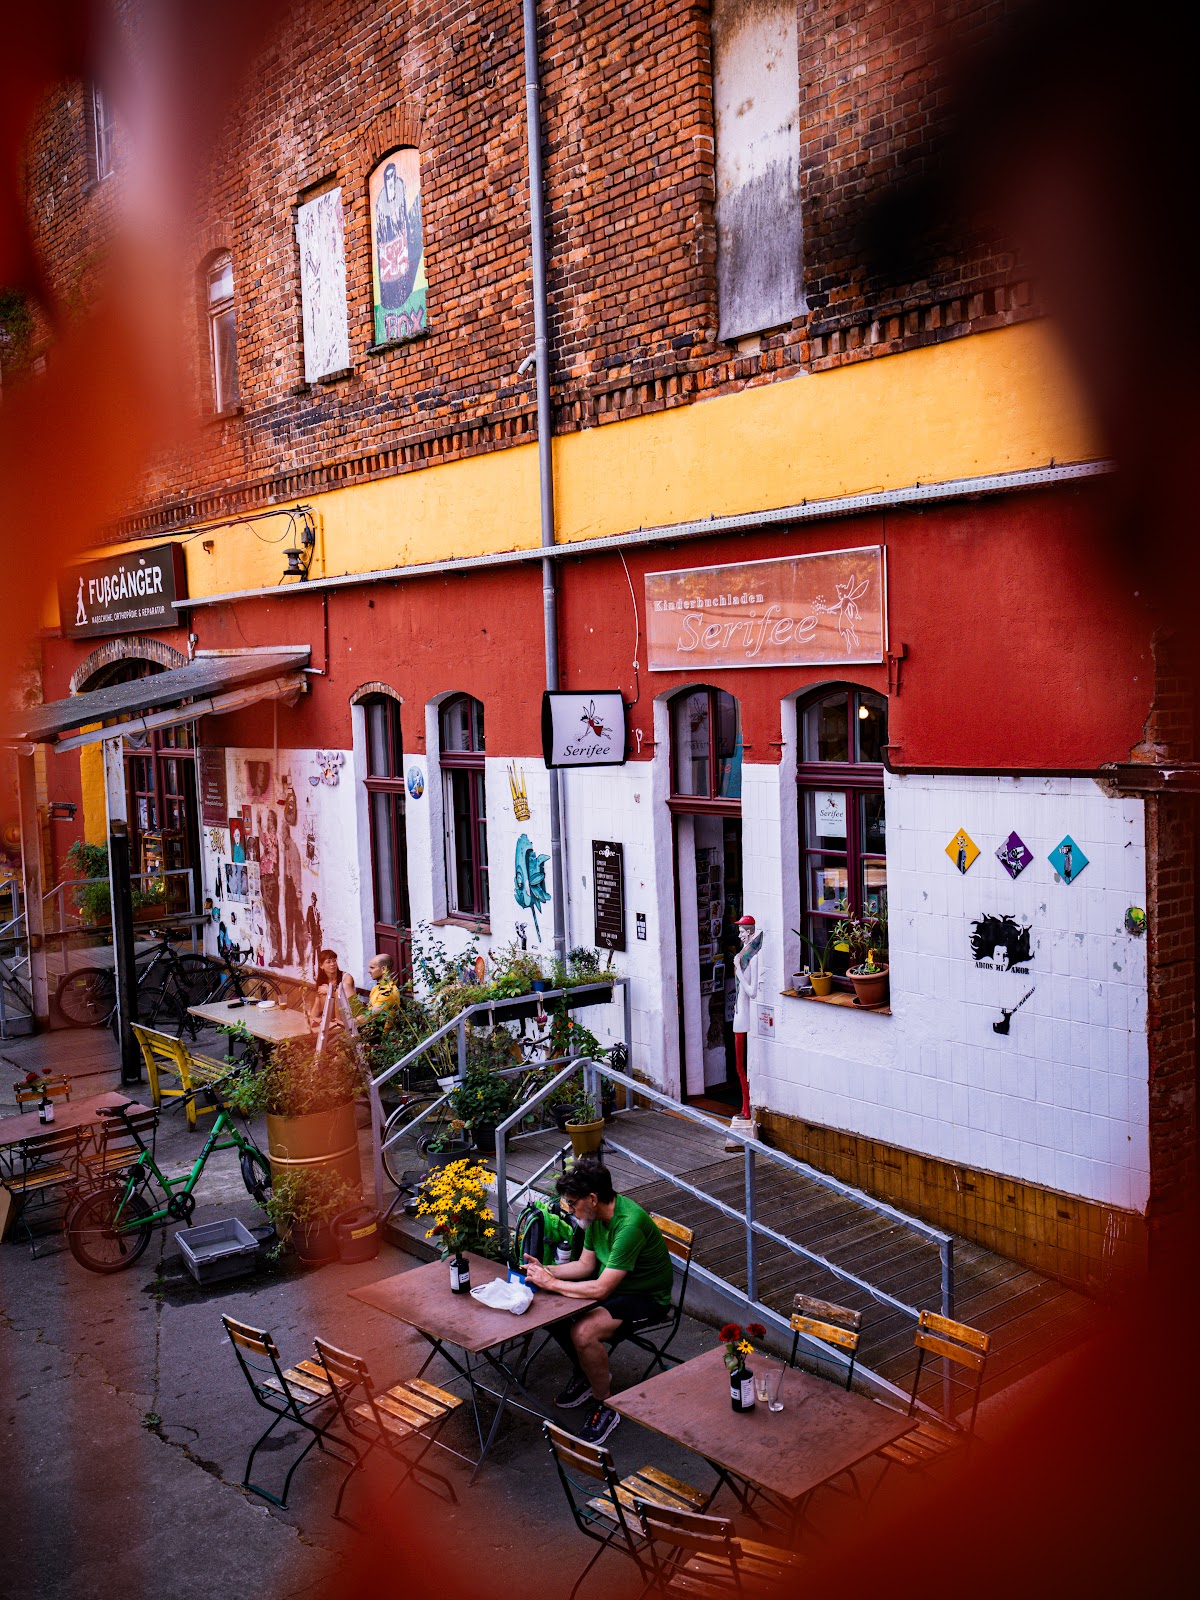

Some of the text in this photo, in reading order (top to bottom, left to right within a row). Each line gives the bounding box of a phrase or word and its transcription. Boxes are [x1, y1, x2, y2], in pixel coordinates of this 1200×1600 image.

[88, 566, 163, 608] FUßGÄNGER
[653, 593, 764, 611] Kinderbuchladen
[141, 606, 165, 616] REPARATUR
[677, 605, 819, 657] Serifee
[563, 744, 610, 758] Serifee
[820, 810, 844, 818] Serifee
[975, 961, 993, 970] ADIOS
[1010, 966, 1029, 974] AMOR
